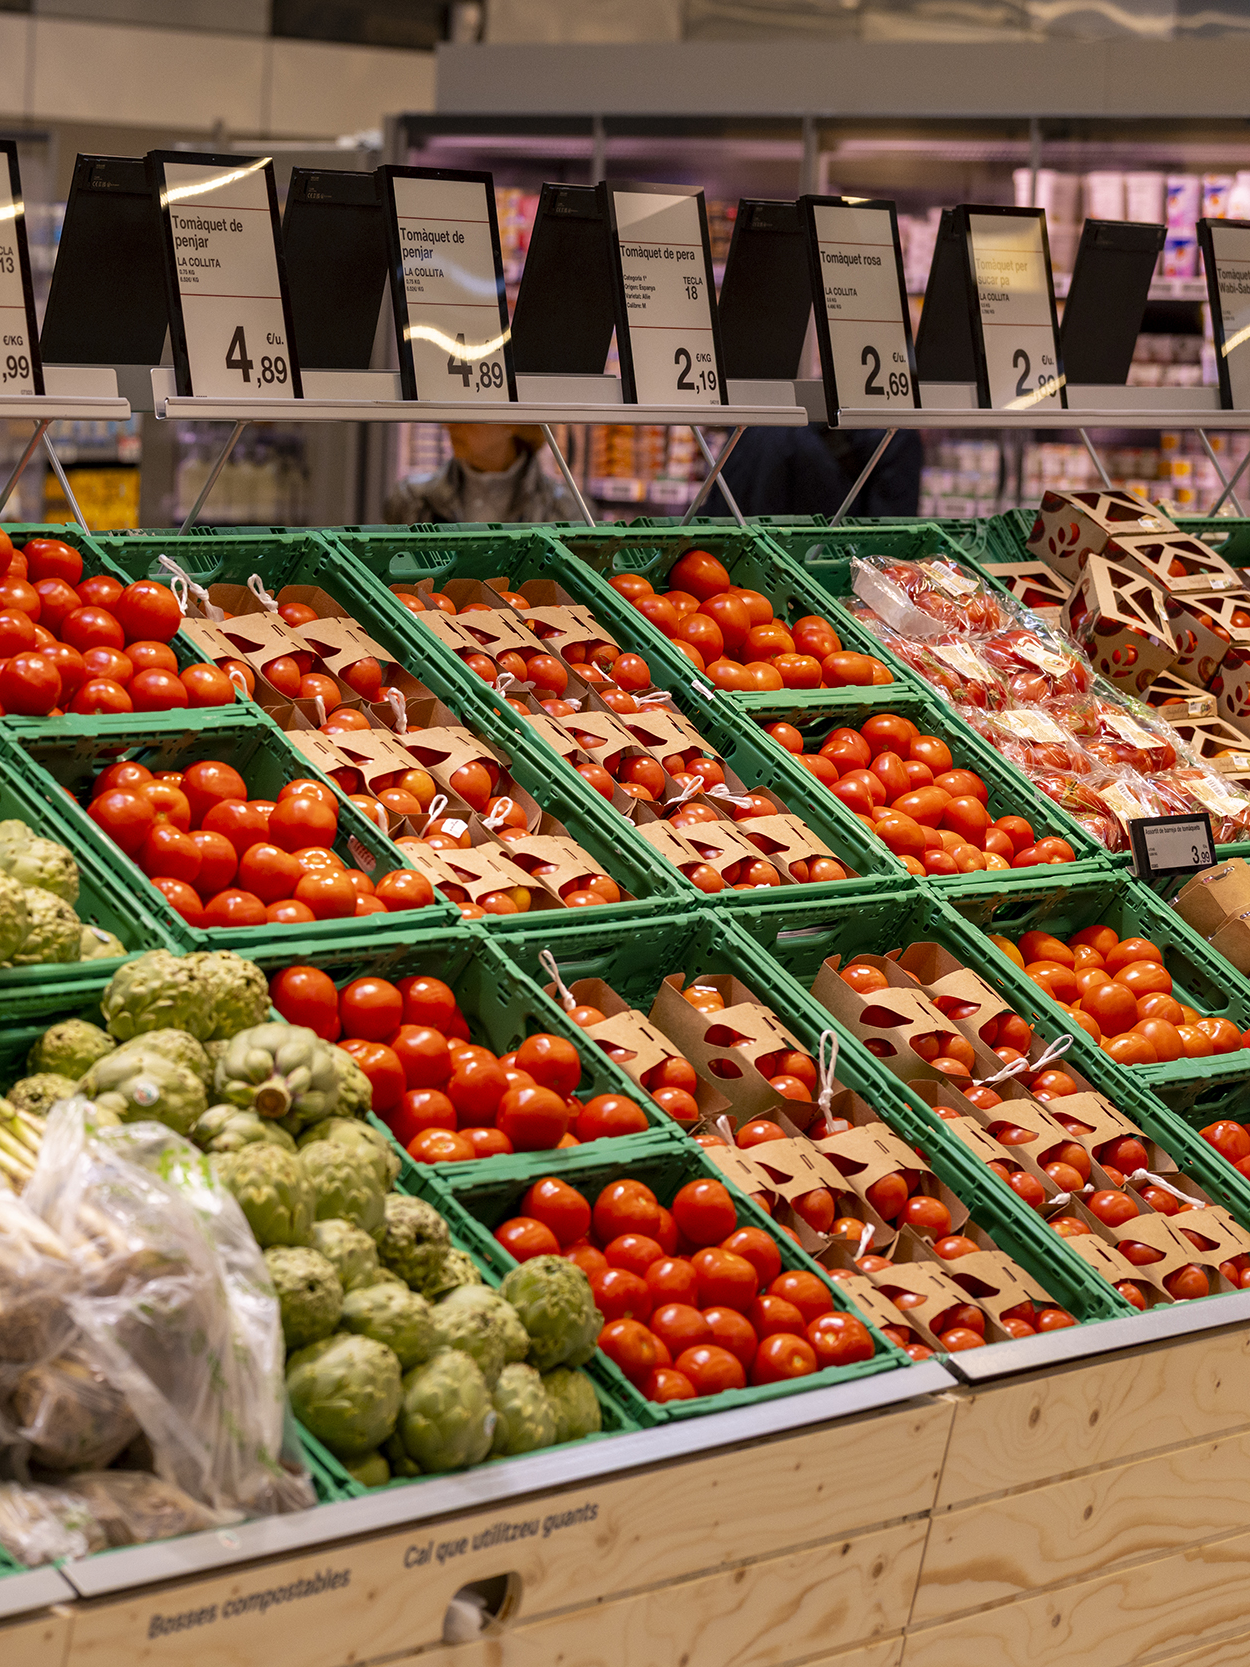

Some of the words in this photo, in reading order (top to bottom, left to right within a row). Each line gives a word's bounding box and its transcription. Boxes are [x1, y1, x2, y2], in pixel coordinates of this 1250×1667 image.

[172, 215, 228, 234] Tomàquet
[230, 219, 243, 232] de
[175, 234, 209, 251] penjar
[399, 227, 451, 245] Tomàquet
[452, 230, 465, 244] de
[402, 246, 434, 261] penjar
[619, 245, 662, 261] Tomàquet
[663, 248, 674, 259] de
[676, 250, 695, 262] pera
[820, 251, 862, 267] Tomàquet
[863, 256, 882, 266] rosa
[177, 257, 188, 266] LA
[188, 257, 221, 268] COLLITA
[976, 258, 1014, 273] Tomàquet
[1016, 262, 1028, 274] per
[404, 267, 413, 276] LA
[414, 268, 444, 278] COLLITA
[683, 276, 703, 286] TECLA
[978, 275, 998, 286] sucar
[1000, 276, 1010, 288] pa
[685, 286, 699, 300] 18
[825, 287, 833, 296] LA
[833, 287, 858, 297] COLLITA
[979, 293, 986, 301] LA
[987, 293, 1010, 302] COLLITA
[3, 335, 23, 346] €/KG
[266, 332, 284, 345] €/u.
[225, 326, 288, 389] 4,89
[447, 333, 504, 393] 4,89
[695, 353, 712, 363] €/KG
[893, 352, 906, 363] €/u.
[674, 347, 717, 395] 2,19
[861, 345, 909, 401] 2,69
[403, 1539, 435, 1569] Cal
[436, 1536, 469, 1566] que
[471, 1519, 540, 1551] utilitzeu
[542, 1502, 599, 1539] guants
[147, 1603, 218, 1640] Bosses
[221, 1567, 351, 1620] compostables
